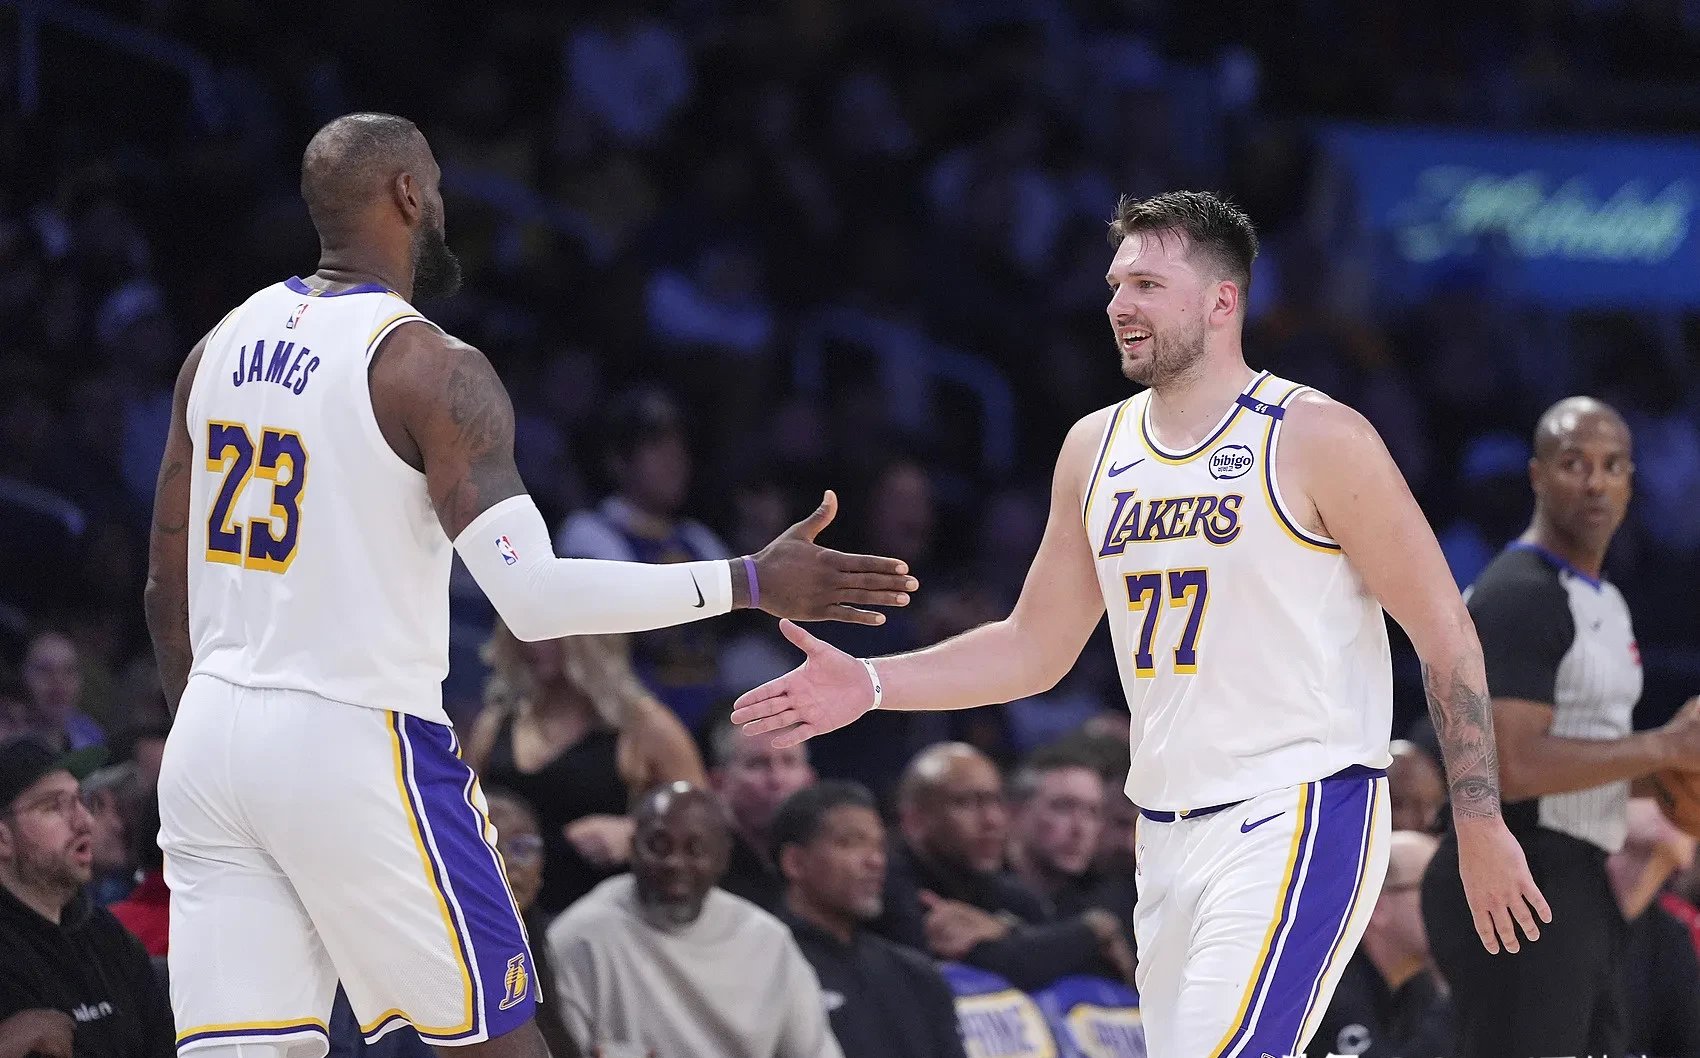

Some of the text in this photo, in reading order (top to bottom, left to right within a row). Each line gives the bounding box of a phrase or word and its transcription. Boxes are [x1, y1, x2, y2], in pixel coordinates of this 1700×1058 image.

[232, 339, 320, 395] JAMES
[1255, 404, 1268, 413] 44
[1213, 454, 1251, 469] bibigo
[205, 419, 310, 575] 23
[1097, 488, 1245, 560] LAKERS
[1122, 567, 1211, 679] 77
